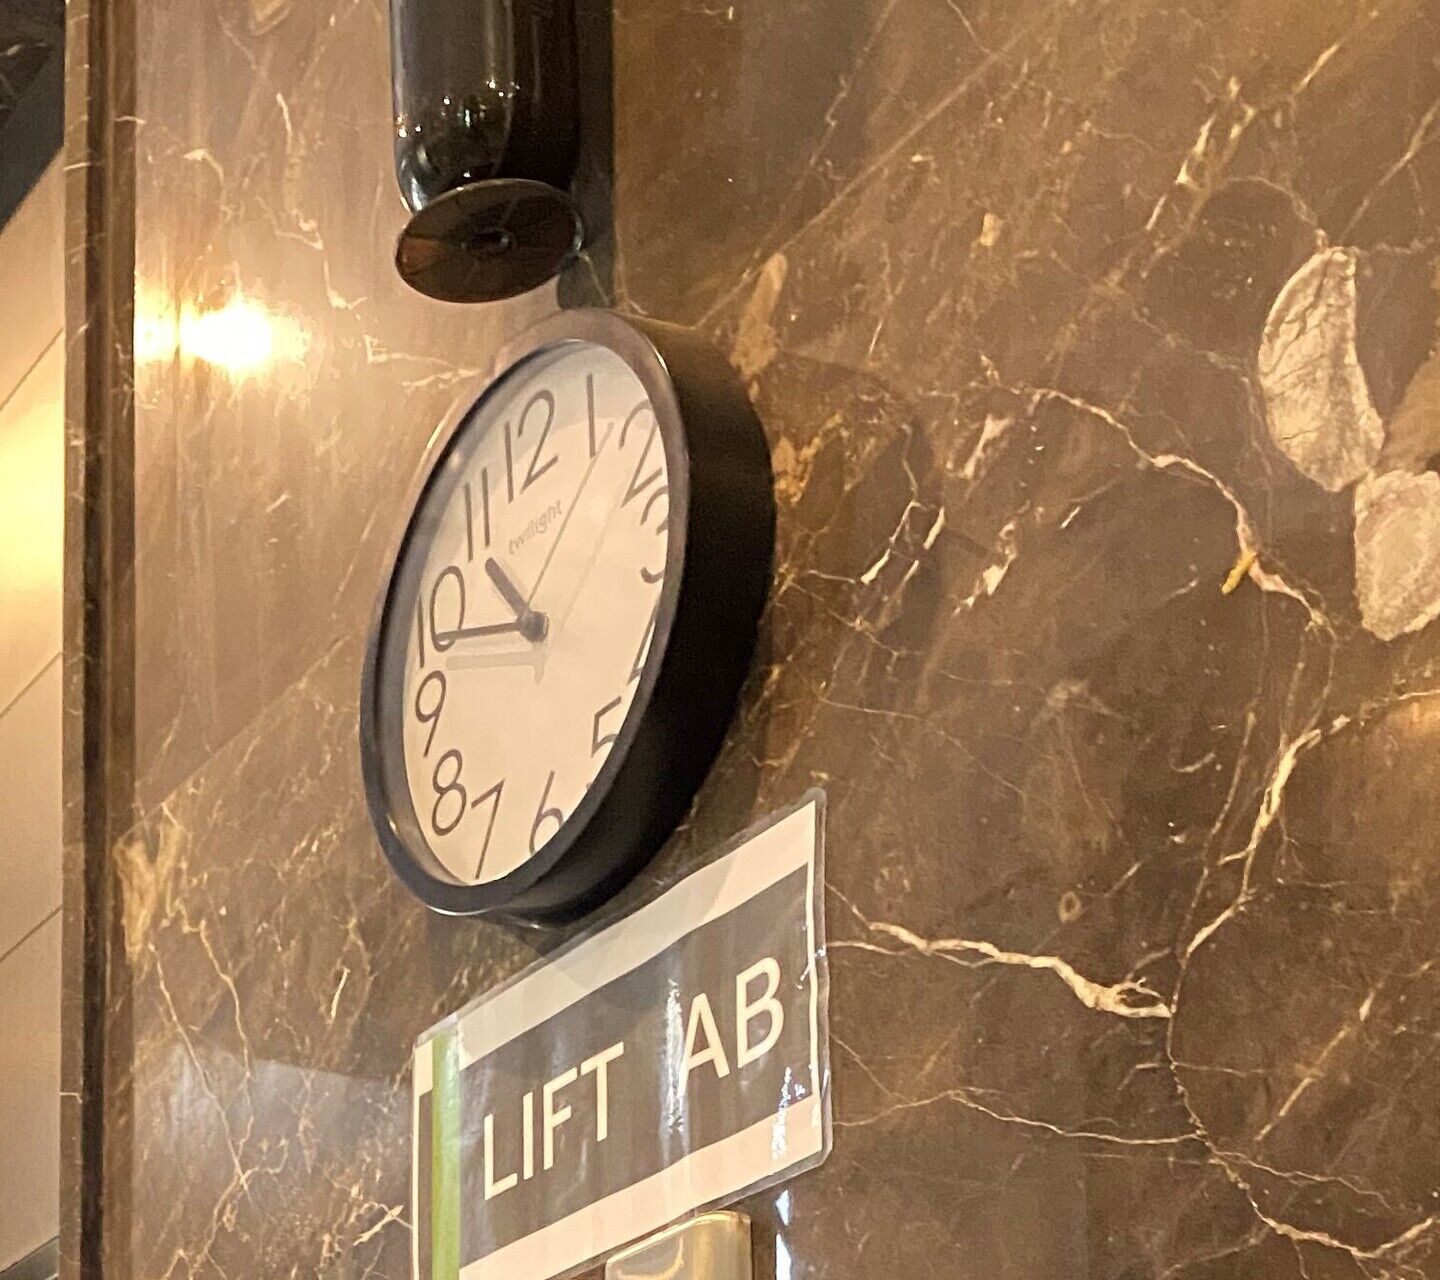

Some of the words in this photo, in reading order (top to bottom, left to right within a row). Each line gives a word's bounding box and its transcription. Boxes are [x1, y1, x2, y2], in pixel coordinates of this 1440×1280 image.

[503, 388, 558, 504] 12
[587, 373, 597, 458] 1
[618, 398, 664, 509] 2
[463, 467, 491, 562] 11
[508, 499, 562, 555] twilight
[417, 565, 466, 668] 10
[414, 670, 447, 757] 9
[431, 748, 466, 837] 8
[471, 779, 506, 881] 7
[529, 770, 565, 856] 6
[483, 1042, 626, 1201] LIFT
[678, 956, 786, 1102] AB
